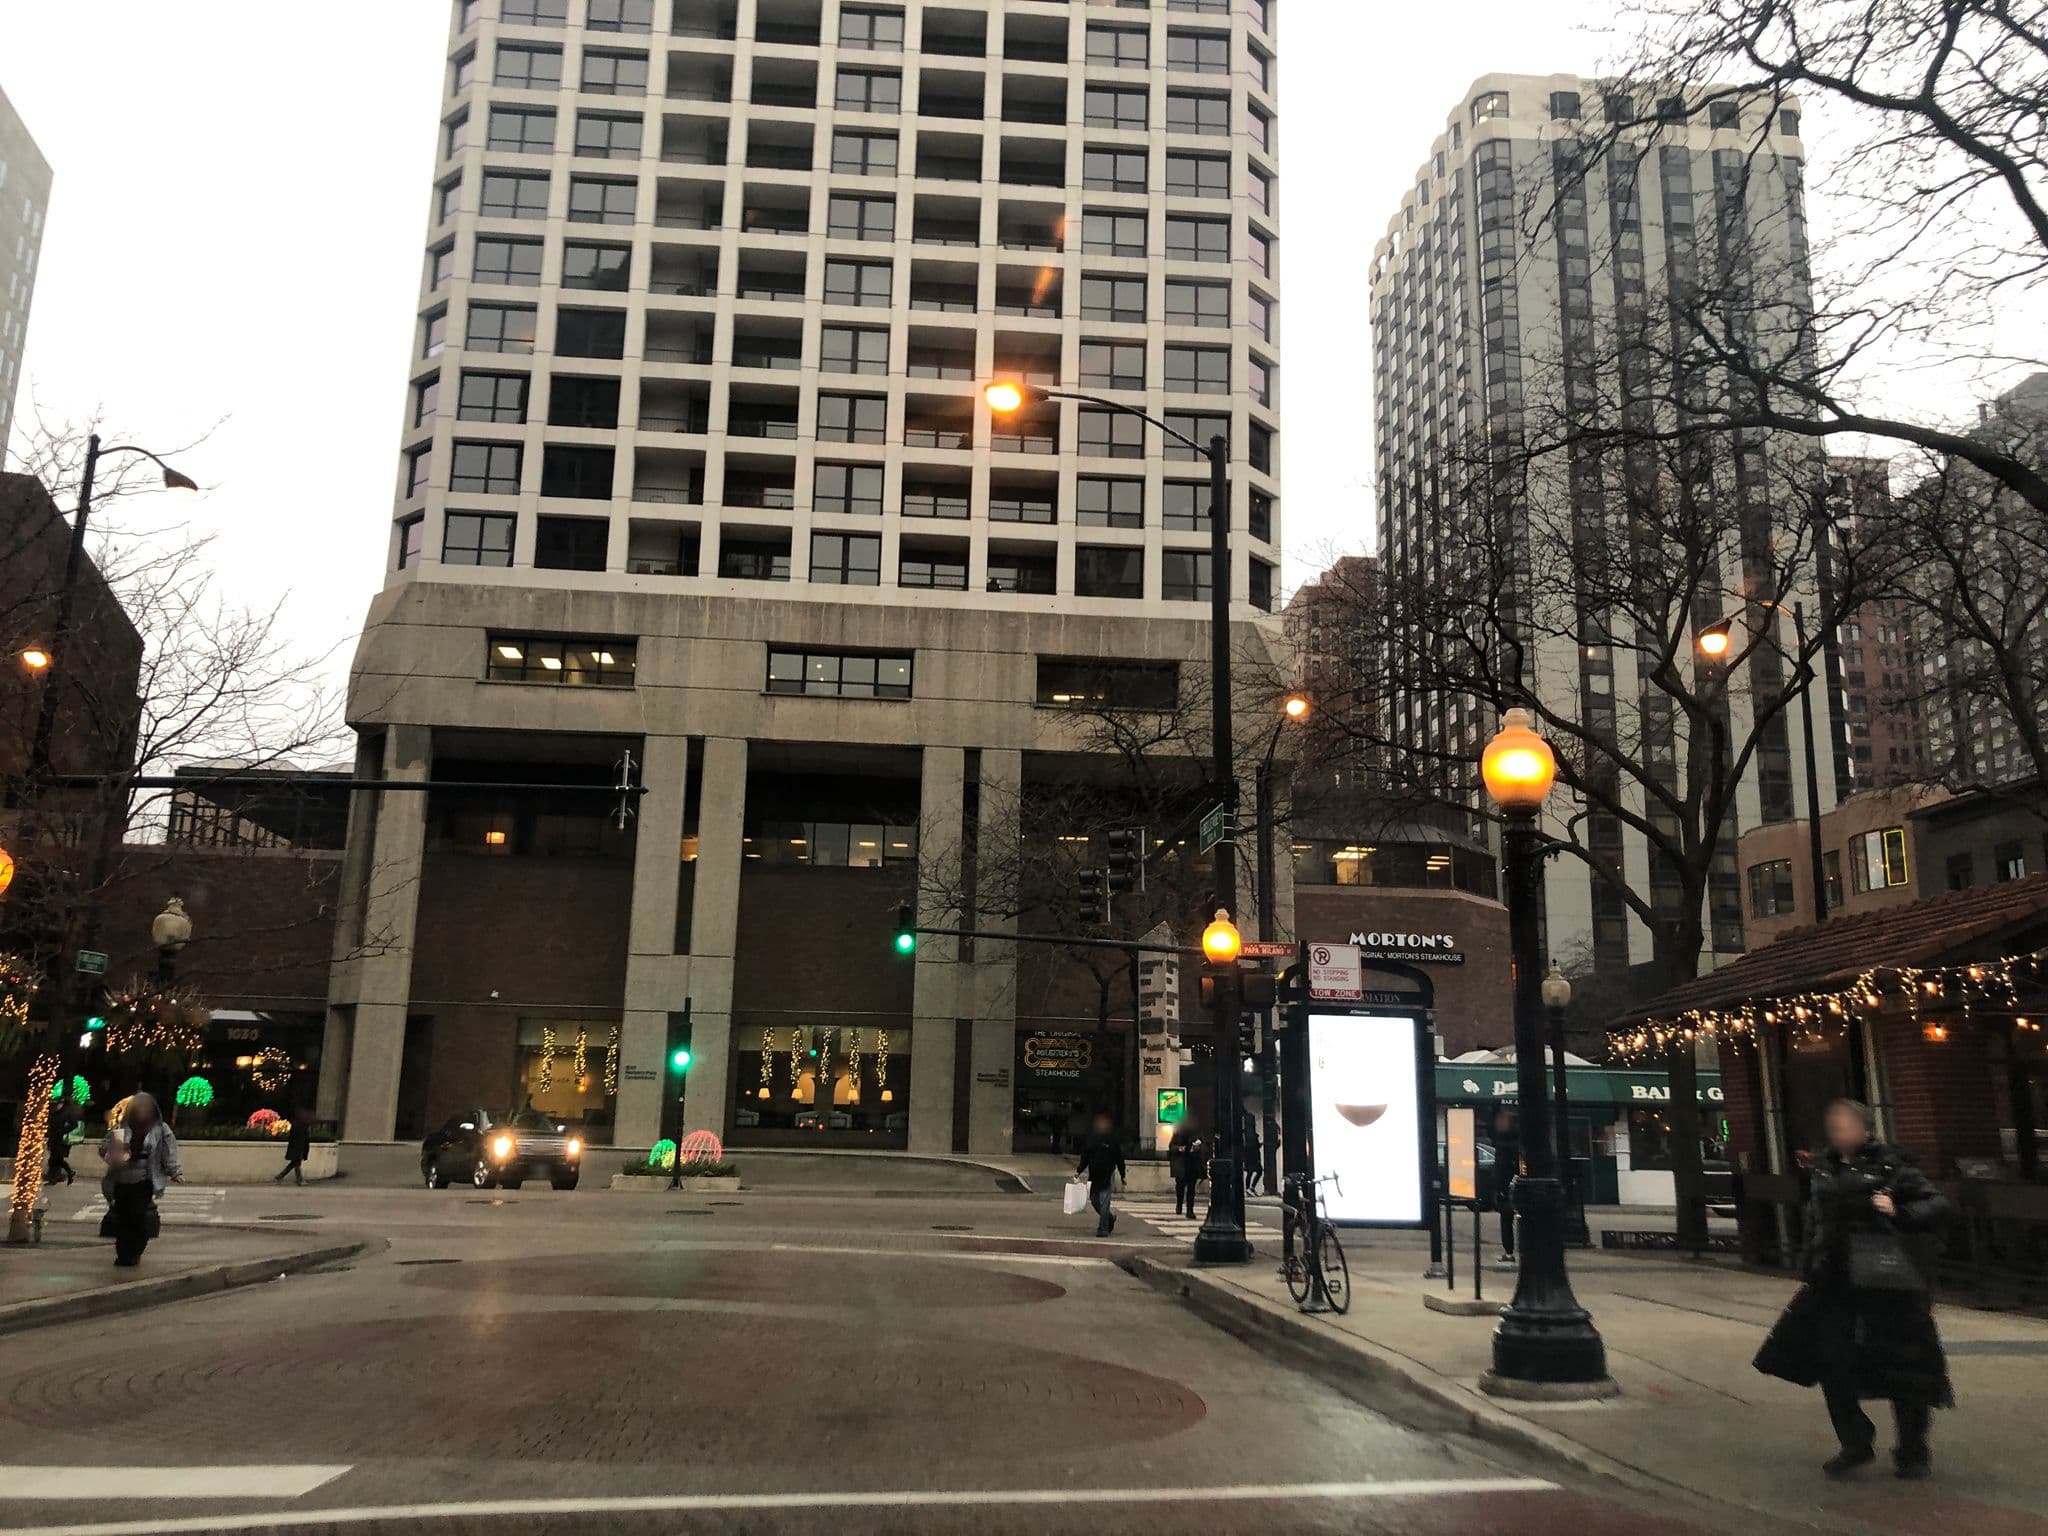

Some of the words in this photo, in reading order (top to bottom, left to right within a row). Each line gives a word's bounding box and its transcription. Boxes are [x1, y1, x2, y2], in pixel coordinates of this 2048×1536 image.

[1349, 932, 1454, 948] MORTON'S
[1244, 946, 1259, 954] PAPA
[1387, 951, 1420, 960] MORTON'S
[1420, 953, 1462, 962] STEAKHOUSE
[1314, 989, 1331, 997] TOW
[1335, 990, 1357, 998] ZONE
[1035, 1069, 1080, 1077] STEAKHOUSE
